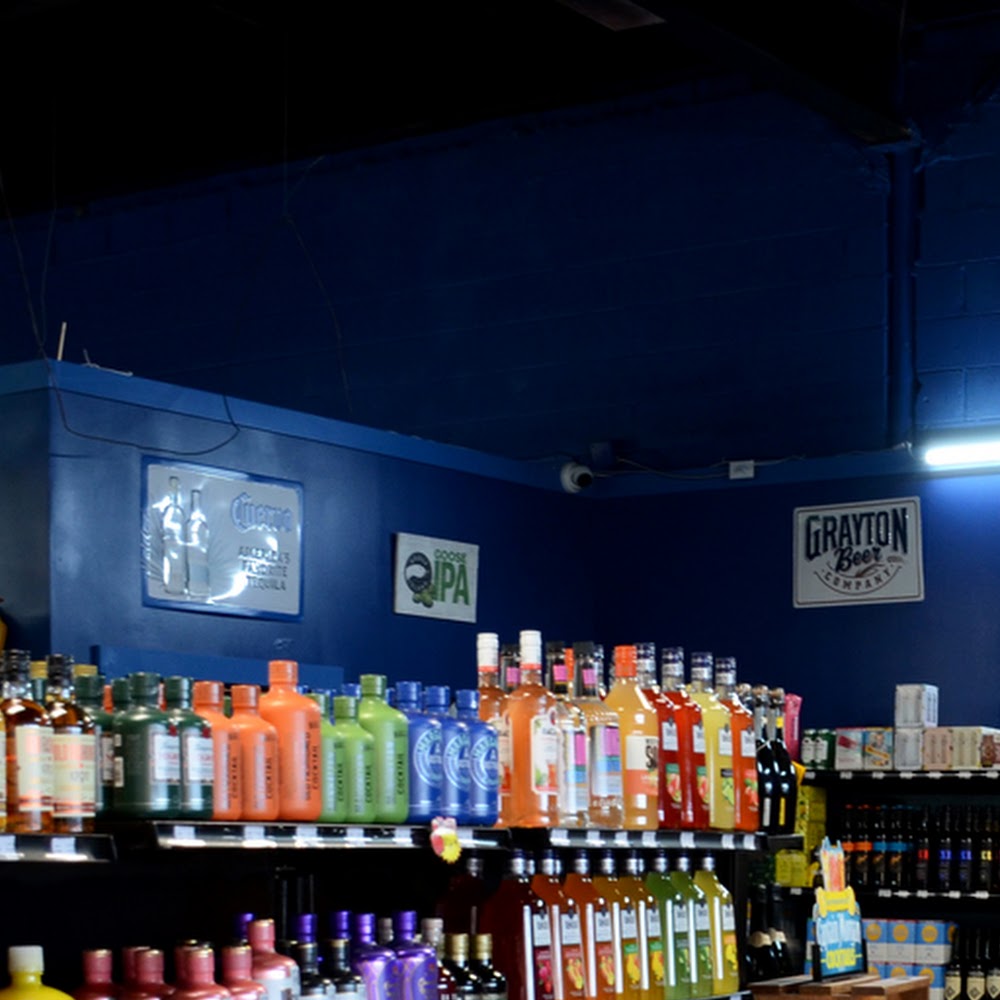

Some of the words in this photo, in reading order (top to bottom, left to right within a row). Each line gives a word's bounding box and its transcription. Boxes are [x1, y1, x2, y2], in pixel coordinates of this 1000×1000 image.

[805, 507, 908, 560] GRAYTON
[834, 546, 881, 572] Beer
[434, 559, 471, 606] IPA
[825, 568, 892, 590] COMPANY
